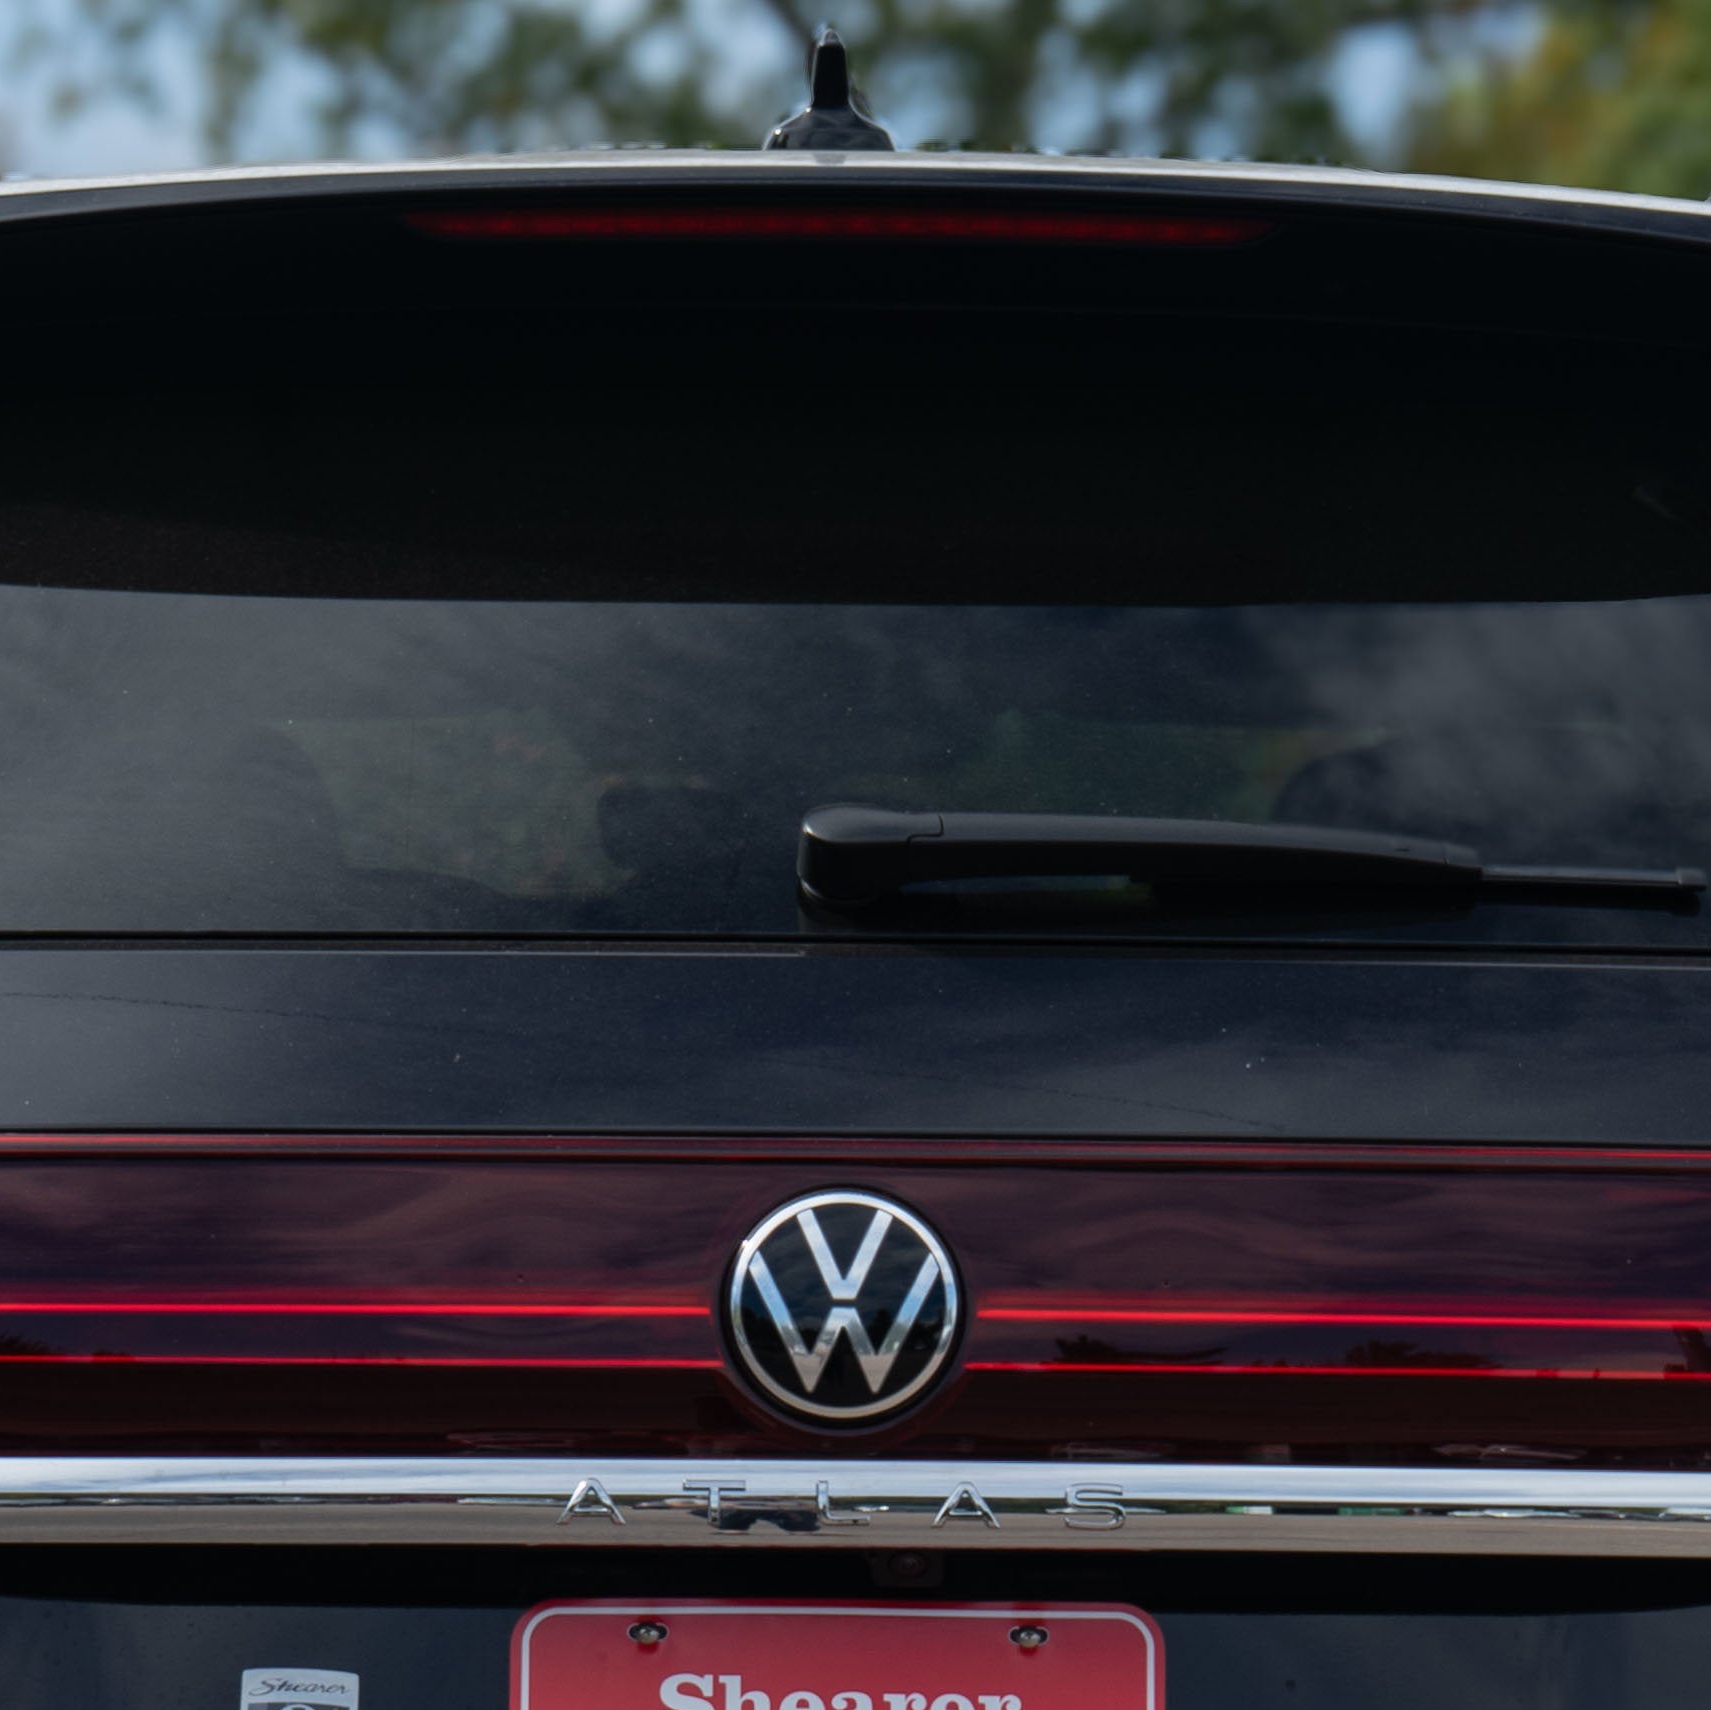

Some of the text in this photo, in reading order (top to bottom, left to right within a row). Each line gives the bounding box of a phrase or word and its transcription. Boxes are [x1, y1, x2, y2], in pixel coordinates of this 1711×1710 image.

[746, 1206, 942, 1396] VW
[555, 1476, 1128, 1531] ATLAS
[248, 1678, 352, 1697] Shearer
